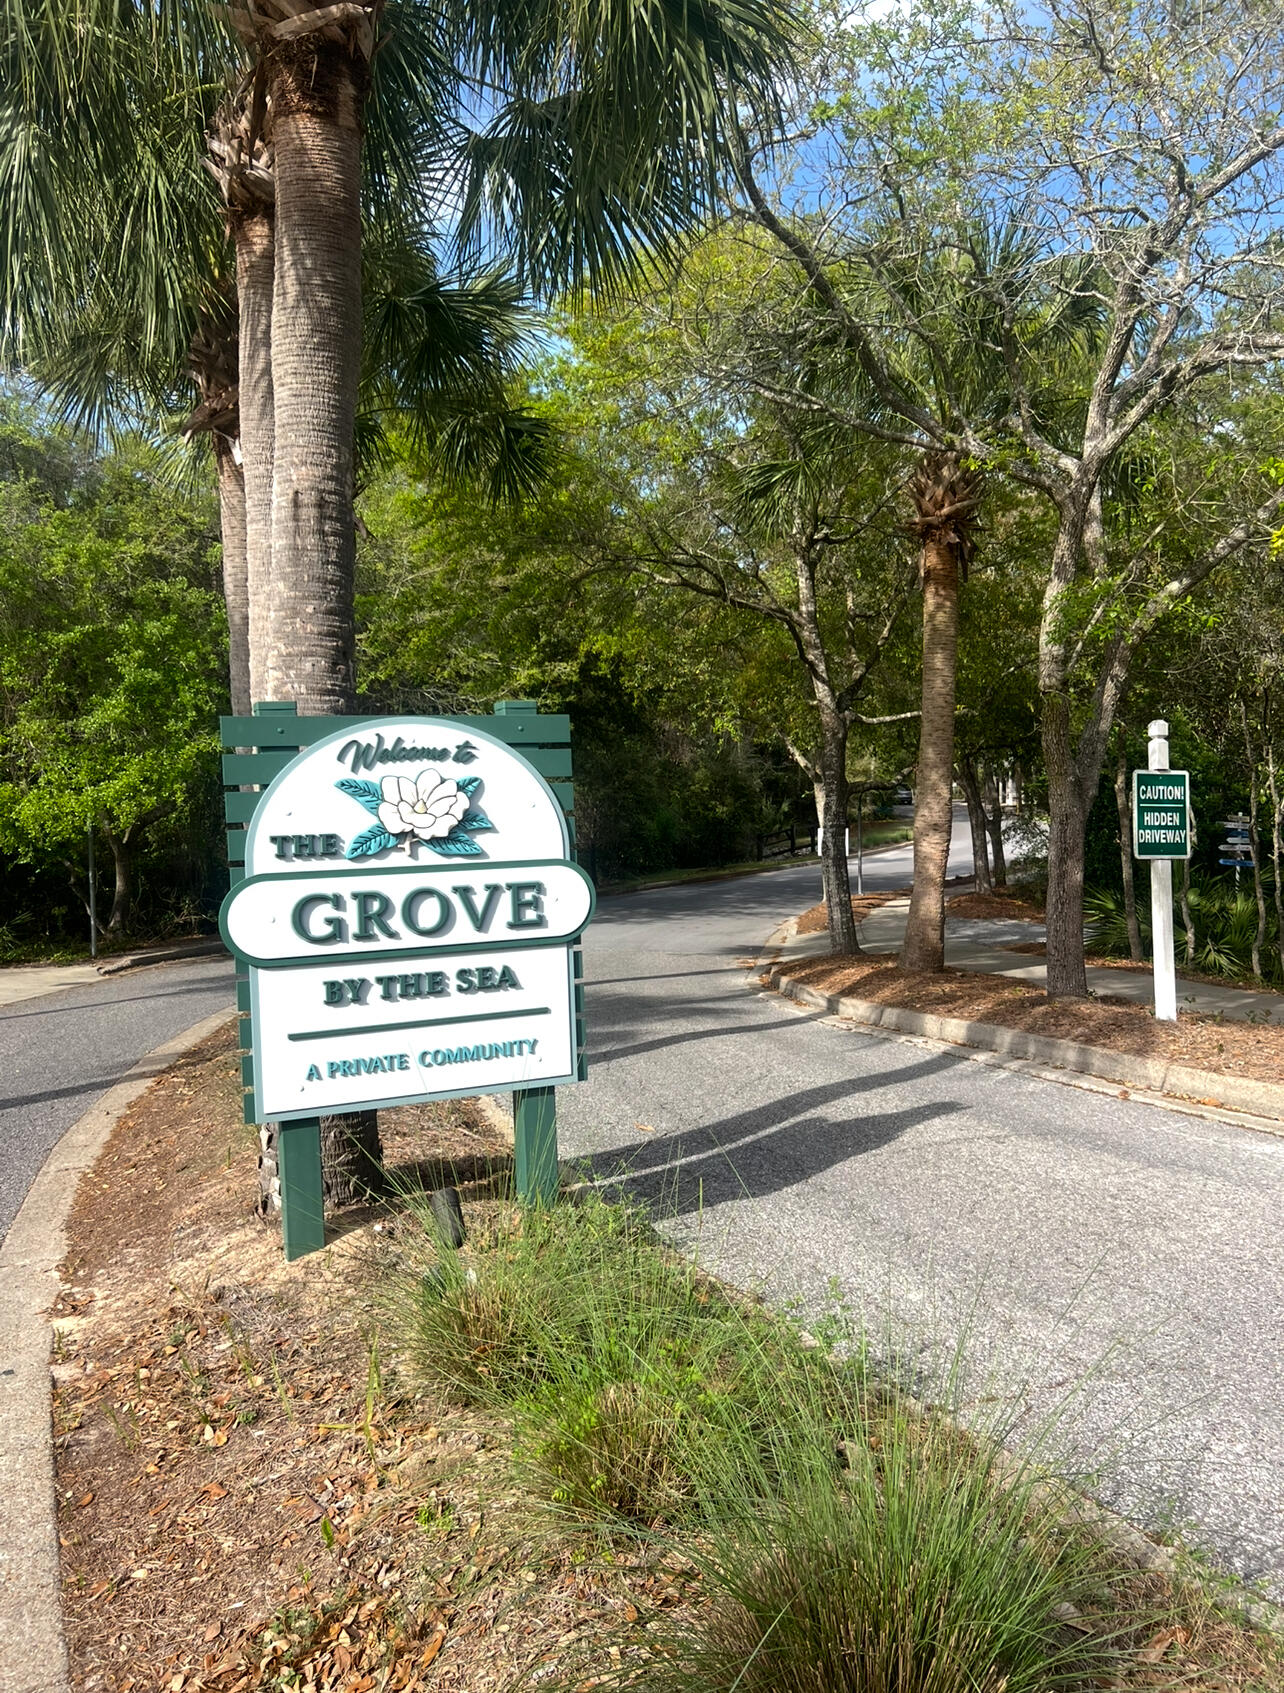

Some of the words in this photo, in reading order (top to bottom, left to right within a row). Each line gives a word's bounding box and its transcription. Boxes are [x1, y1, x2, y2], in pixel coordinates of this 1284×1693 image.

[337, 733, 449, 774] Welcome
[450, 740, 479, 765] to
[1139, 785, 1184, 800] CAUTION!
[1143, 812, 1180, 826] HIDDEN
[269, 833, 341, 859] THE
[1138, 829, 1186, 844] DRIVEWAY
[291, 881, 546, 943] GROVE
[322, 978, 366, 1005] BY
[375, 971, 449, 1000] THE
[456, 965, 519, 993] SEA
[305, 1064, 321, 1081] A
[326, 1053, 410, 1079] PRIVATE
[418, 1038, 538, 1068] COMMUNITY
